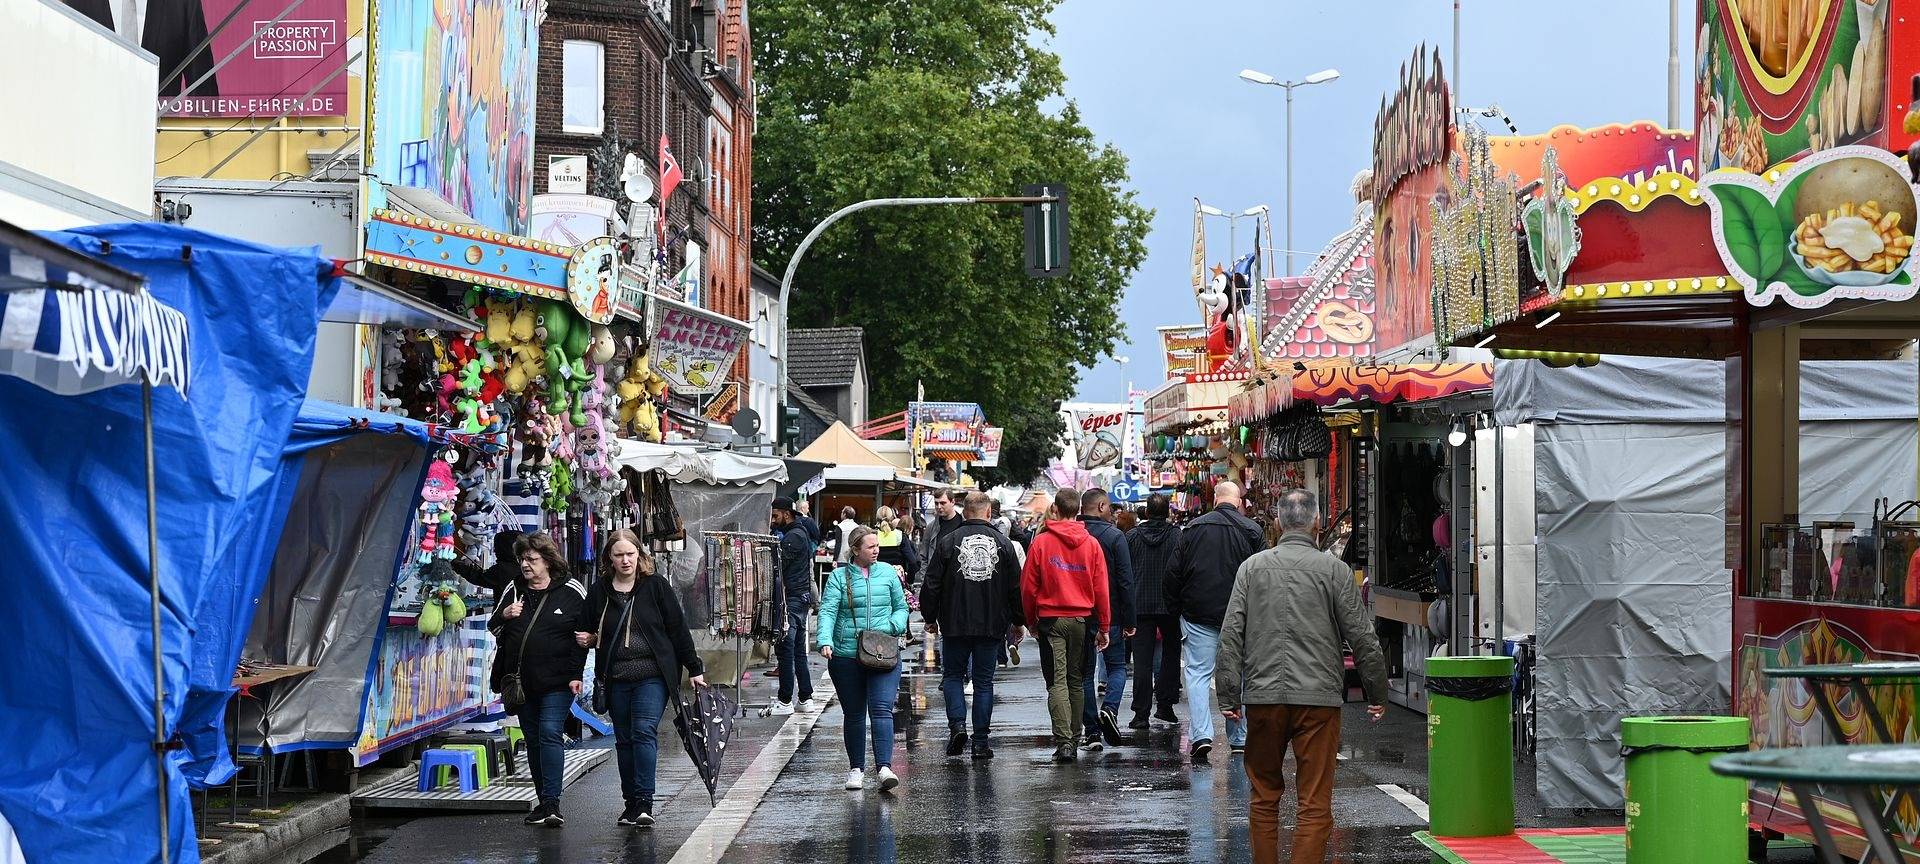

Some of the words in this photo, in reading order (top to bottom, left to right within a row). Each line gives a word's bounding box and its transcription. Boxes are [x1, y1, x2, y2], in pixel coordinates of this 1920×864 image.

[260, 26, 329, 39] PROPERTY
[260, 40, 317, 52] PASSION
[554, 175, 582, 183] VELTINS
[656, 327, 736, 354] ANGELN
